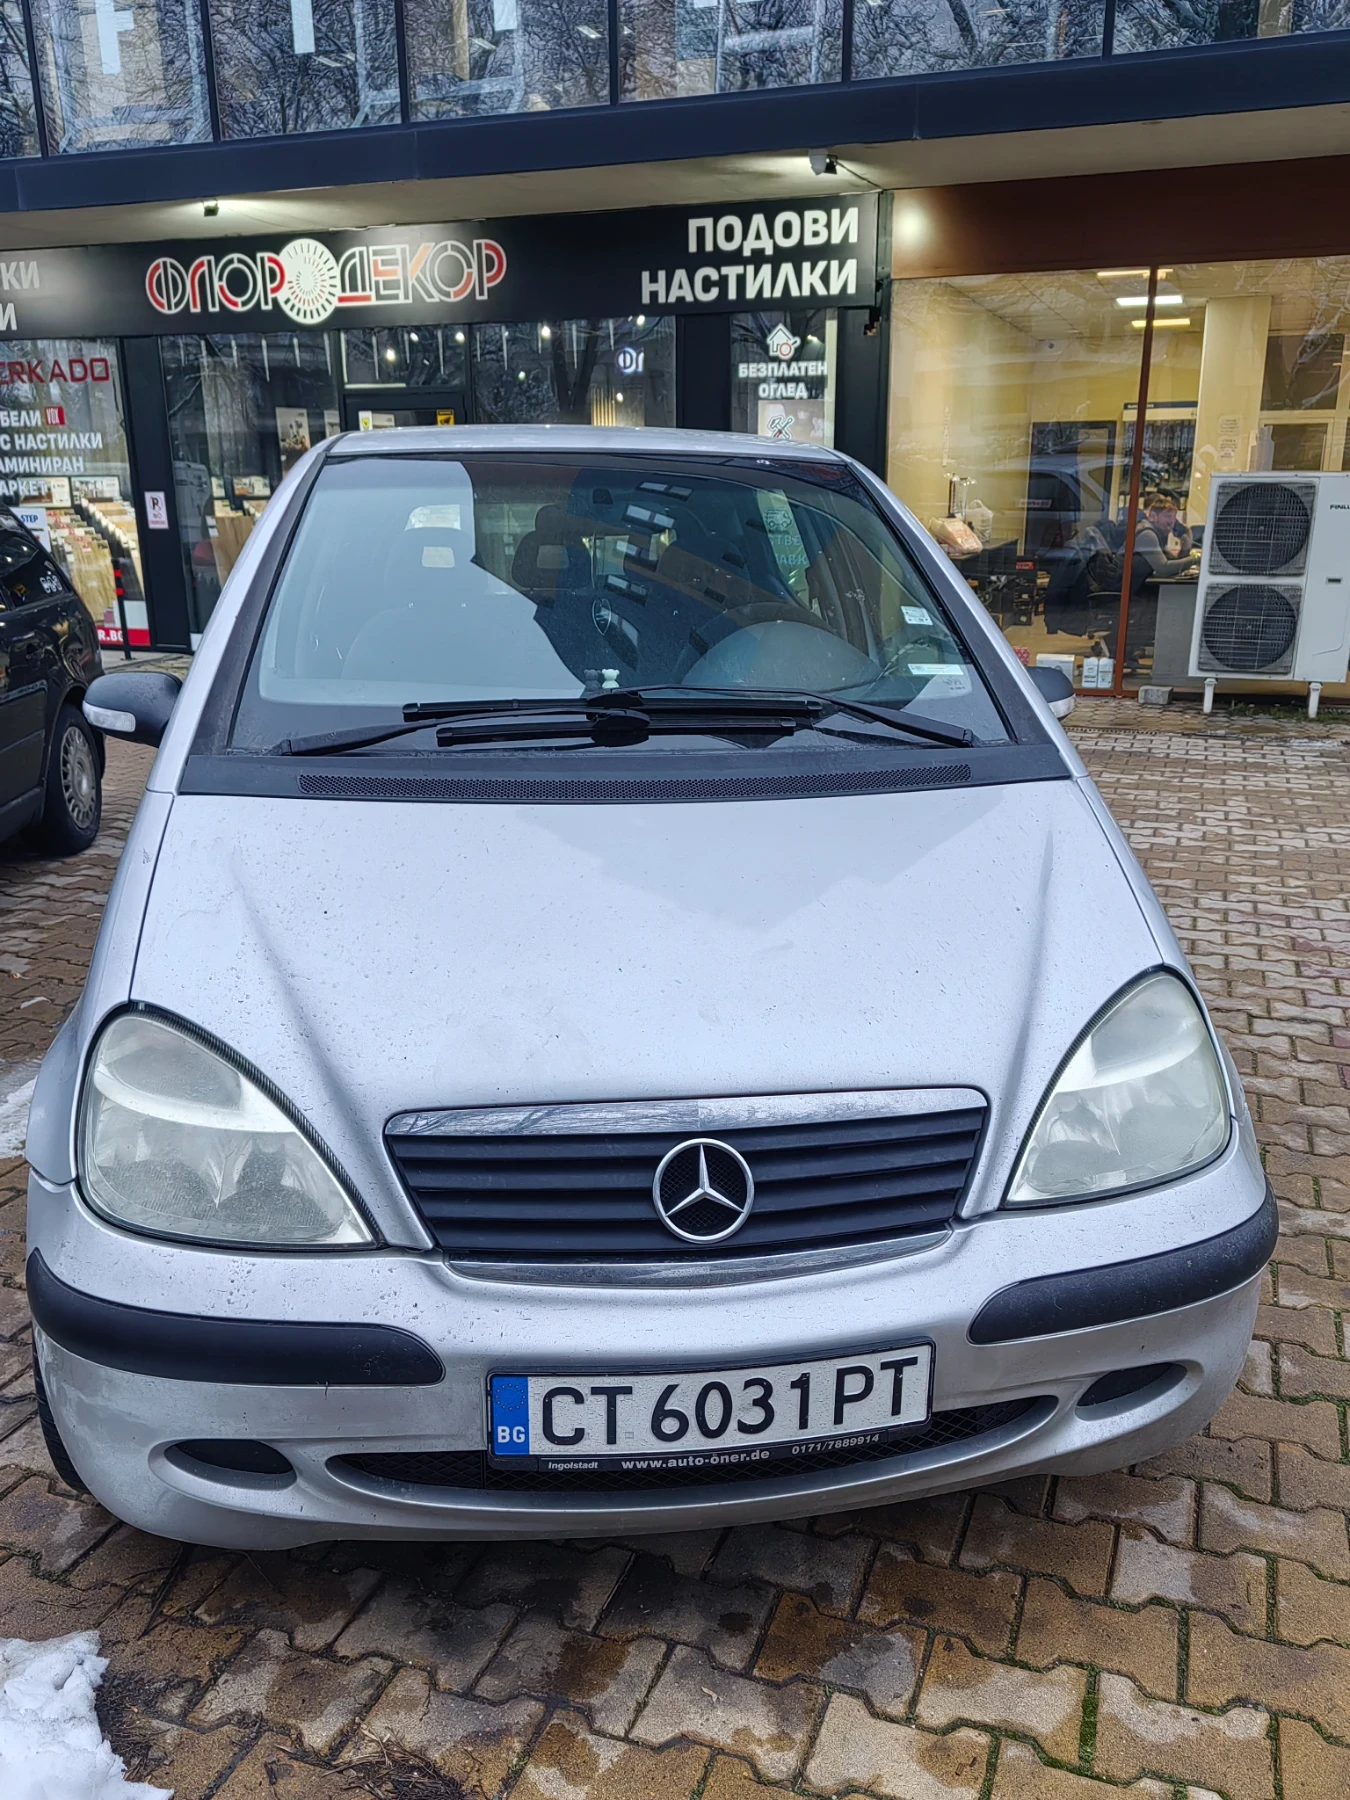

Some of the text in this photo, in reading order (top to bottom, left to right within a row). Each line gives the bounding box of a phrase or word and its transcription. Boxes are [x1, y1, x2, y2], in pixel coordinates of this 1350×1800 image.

[688, 207, 859, 257] ПОДОВИ
[641, 258, 858, 304] НАСТИЛКИ
[738, 360, 828, 378] БЕЗПЛАТЕН
[758, 383, 808, 399] ОГЛЕД
[14, 432, 104, 450] НАСТИЛКИ
[542, 1356, 919, 1446] CT 6031 PT
[497, 1426, 526, 1443] BG
[548, 1433, 880, 1471] Ingolstadt www.auto-öner.de 0171/7889914
